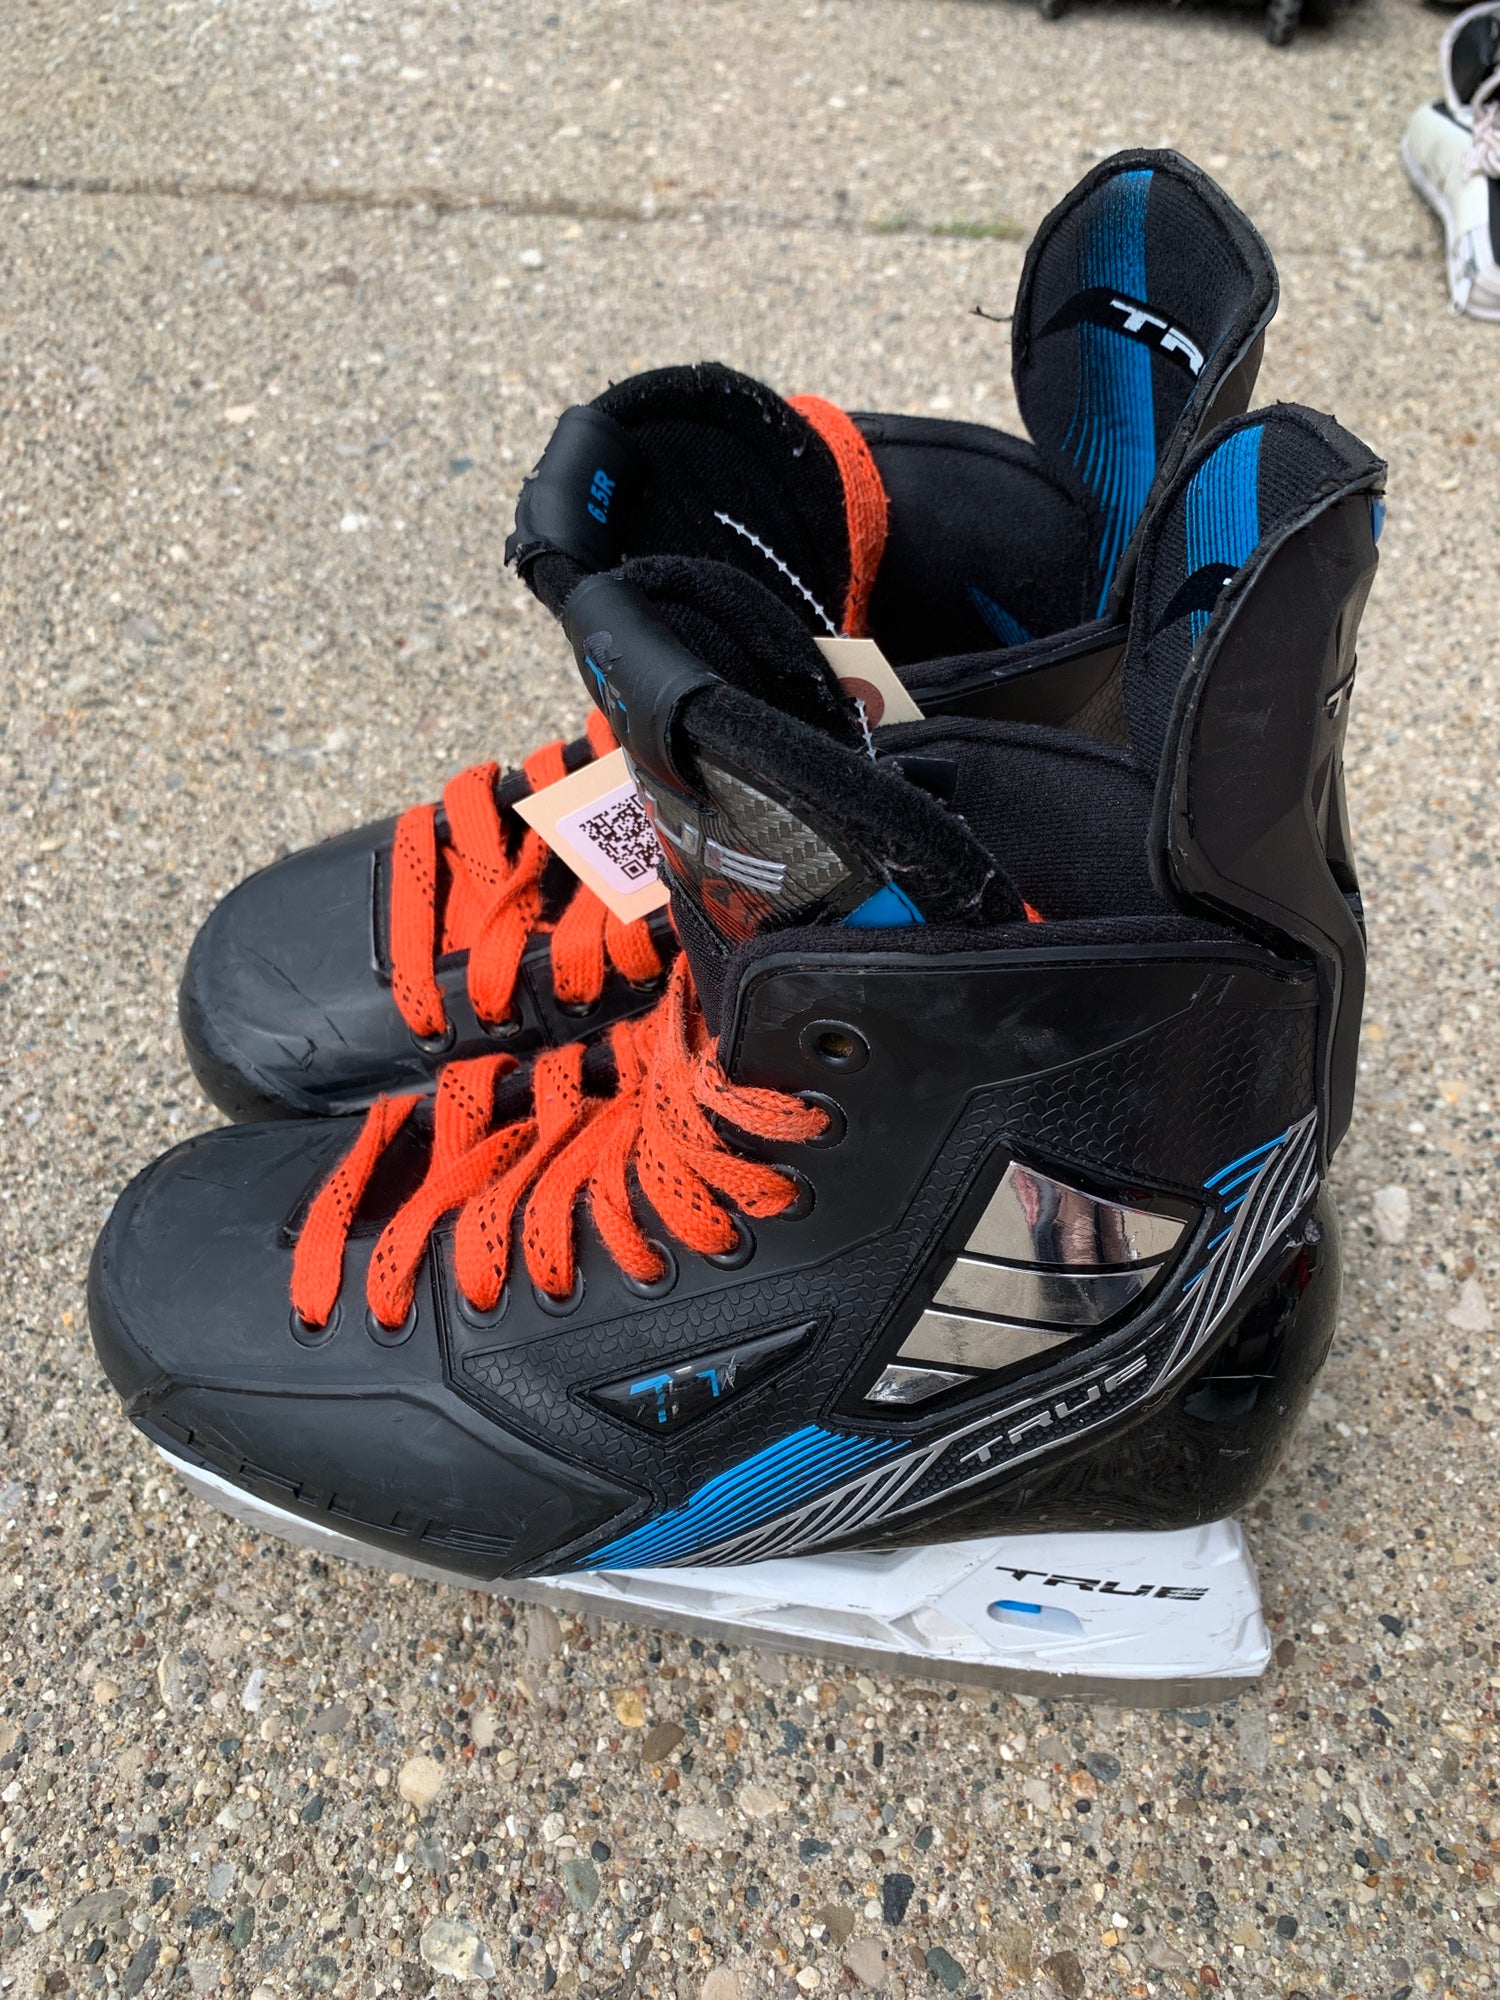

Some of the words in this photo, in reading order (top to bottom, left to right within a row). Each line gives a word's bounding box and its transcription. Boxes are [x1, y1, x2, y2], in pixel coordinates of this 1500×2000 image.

[1109, 299, 1206, 377] TR
[586, 468, 616, 524] 6.5R
[959, 1354, 1148, 1463] TRUE
[995, 1565, 1210, 1601] TRUE
